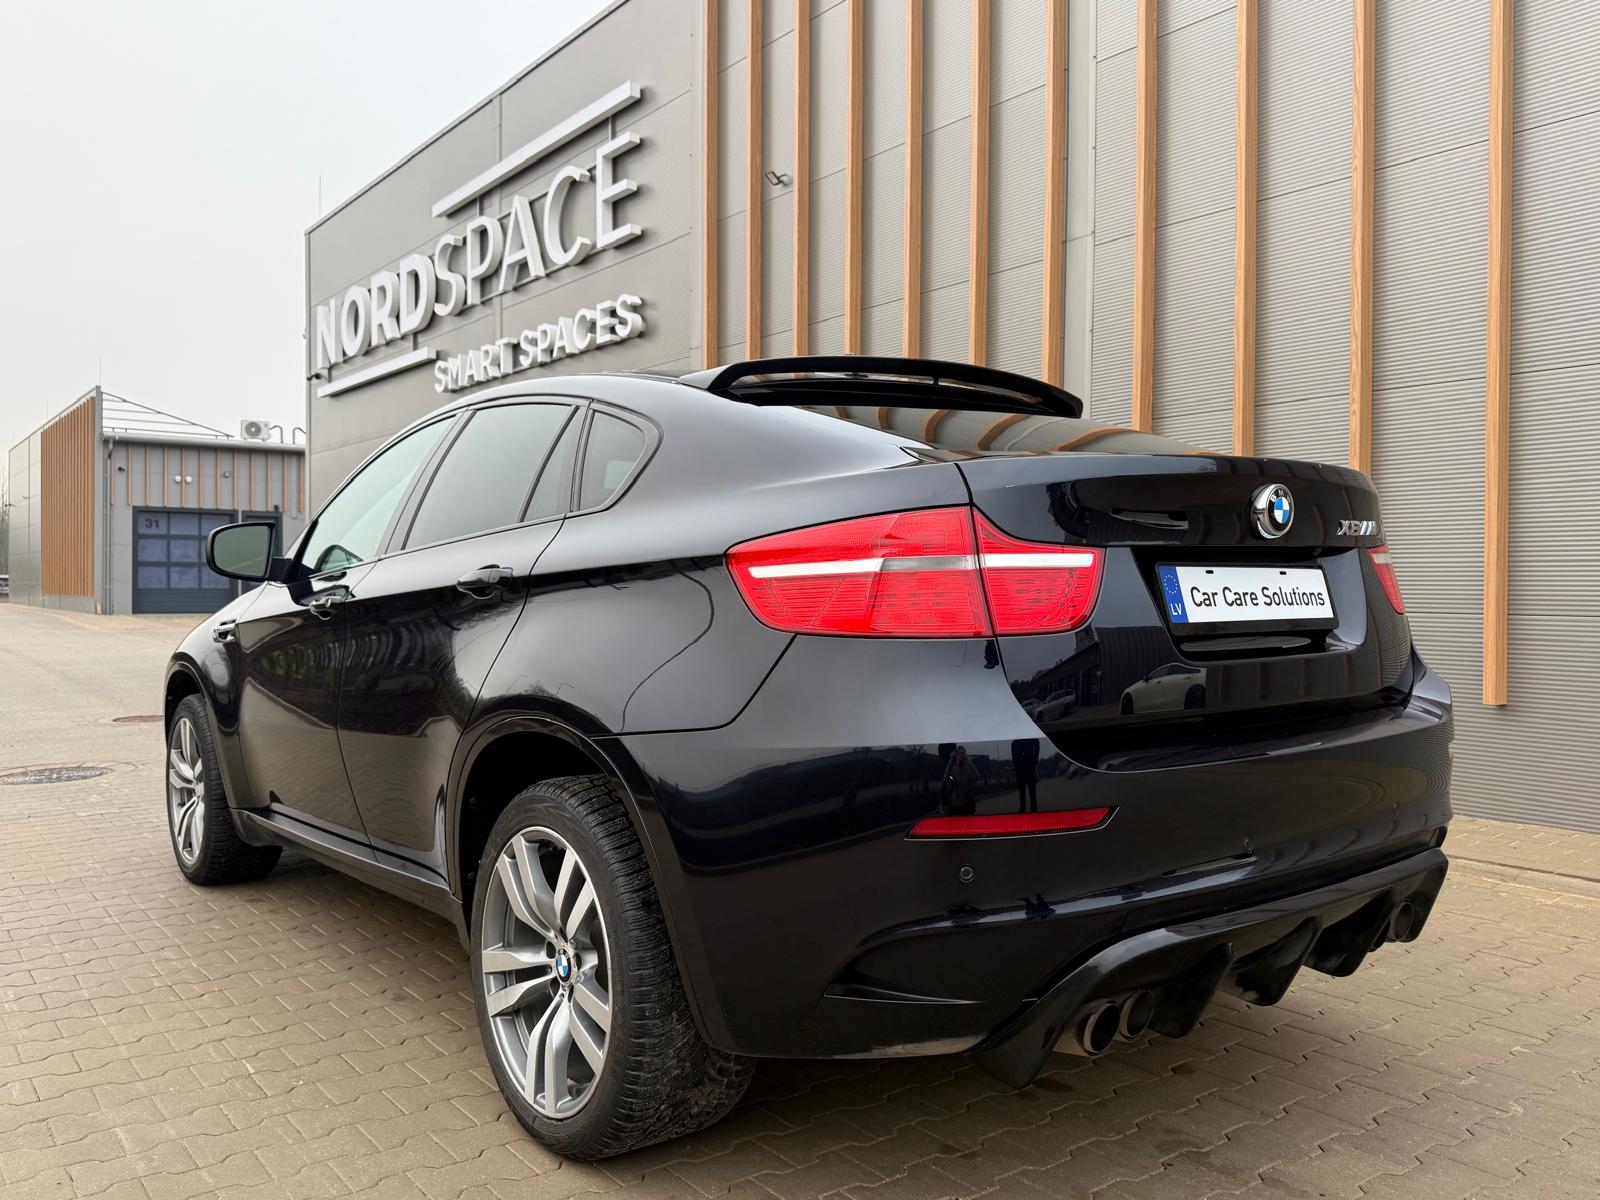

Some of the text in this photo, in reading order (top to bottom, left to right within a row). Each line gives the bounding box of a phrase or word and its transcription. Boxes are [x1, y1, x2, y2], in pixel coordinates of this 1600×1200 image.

[316, 131, 642, 369] NORDSPACE
[434, 293, 645, 393] SMART SPACES
[144, 518, 160, 529] 31
[1190, 586, 1325, 607] Car Care Solutions
[1170, 603, 1182, 616] LV
